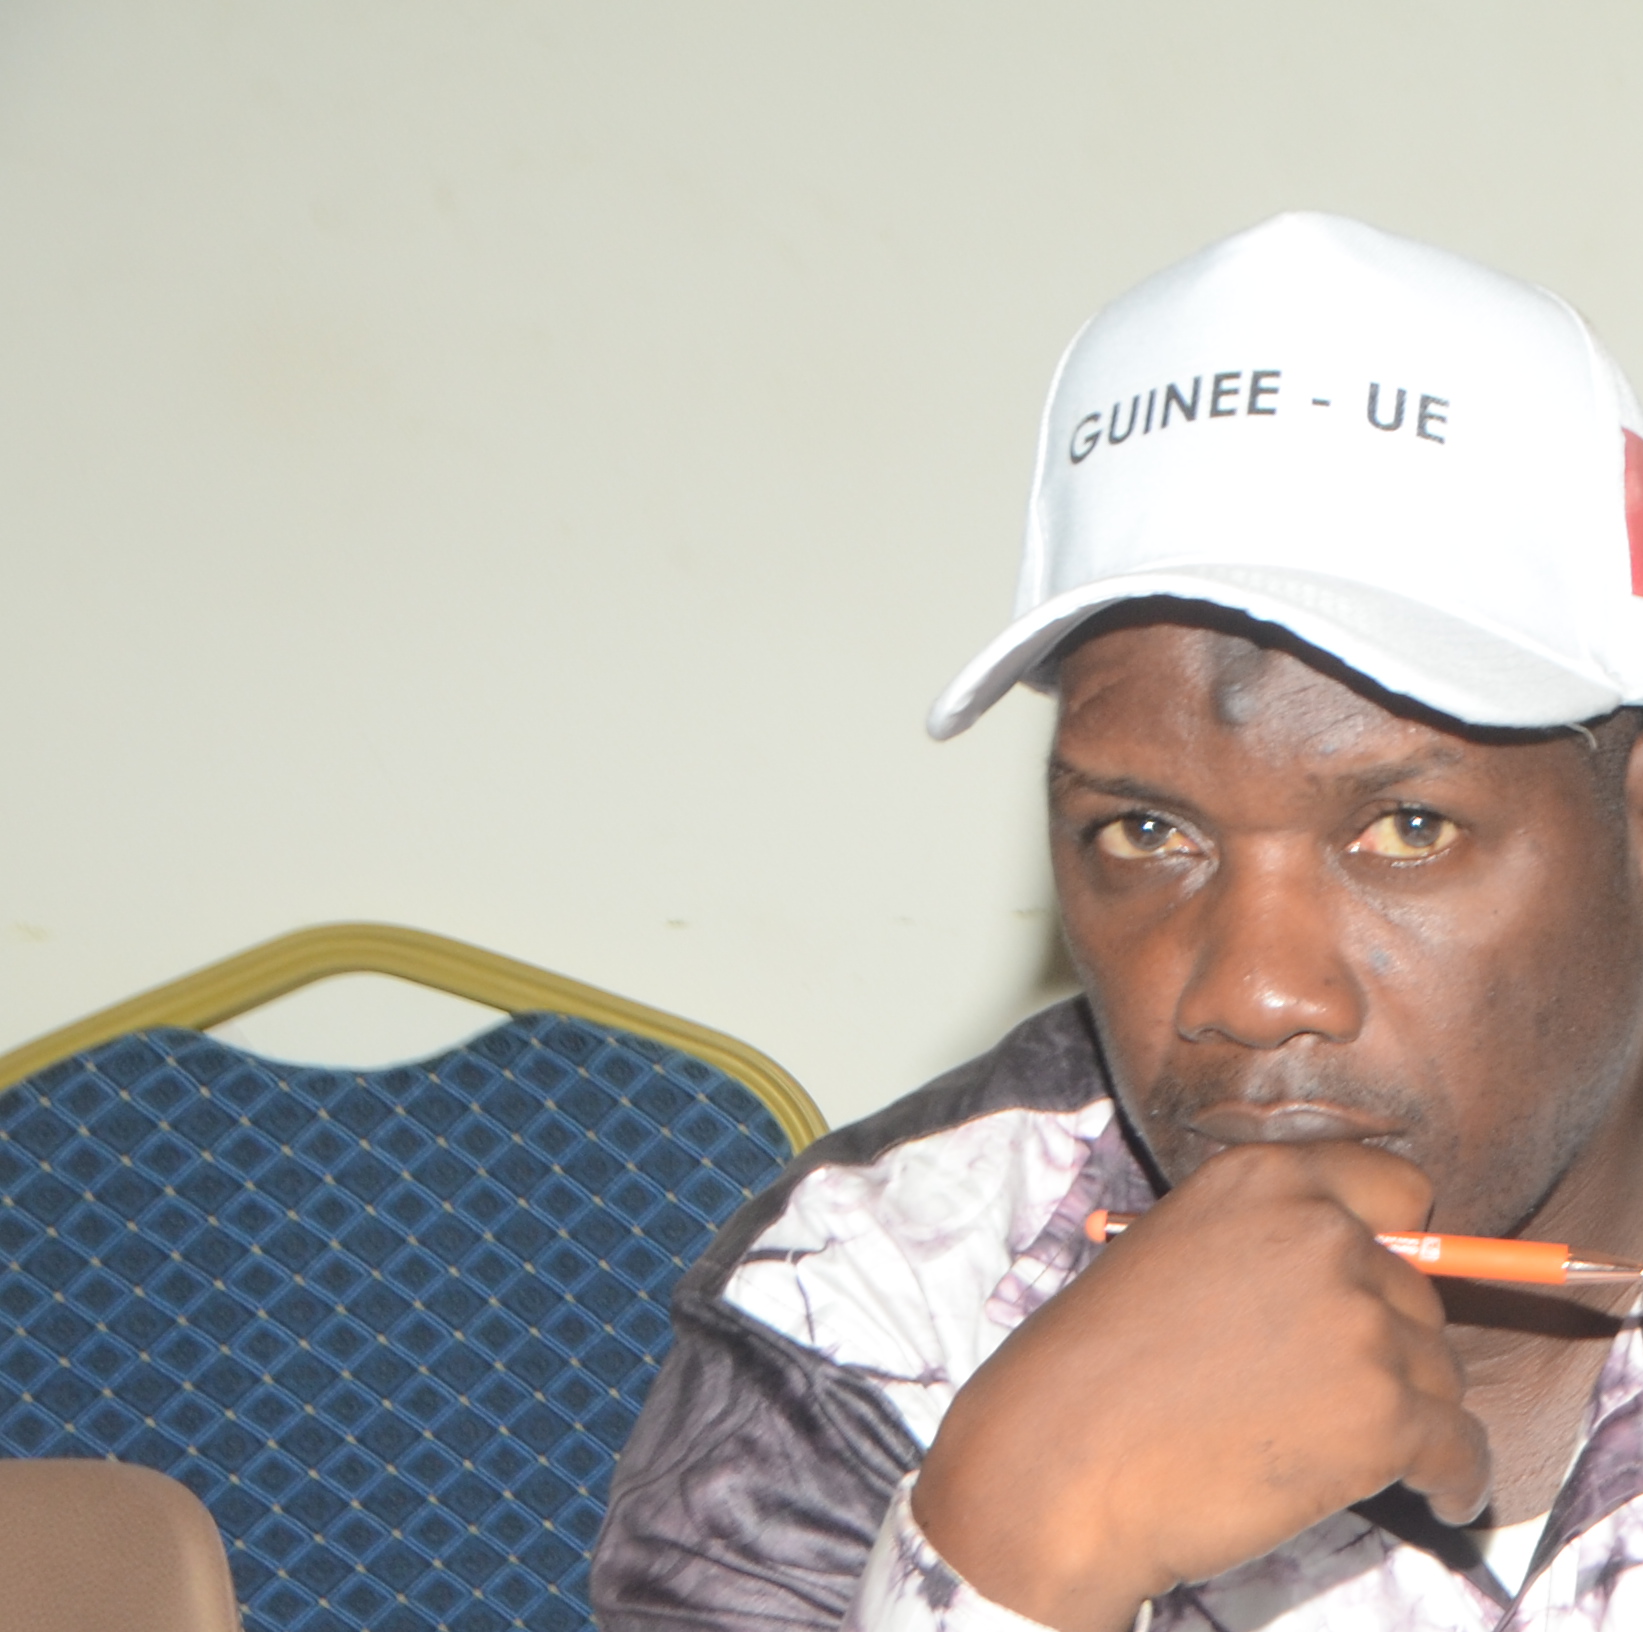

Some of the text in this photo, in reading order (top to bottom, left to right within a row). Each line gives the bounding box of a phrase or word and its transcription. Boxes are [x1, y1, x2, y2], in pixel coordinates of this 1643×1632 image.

[1069, 369, 1450, 465] GUINEE - UE
